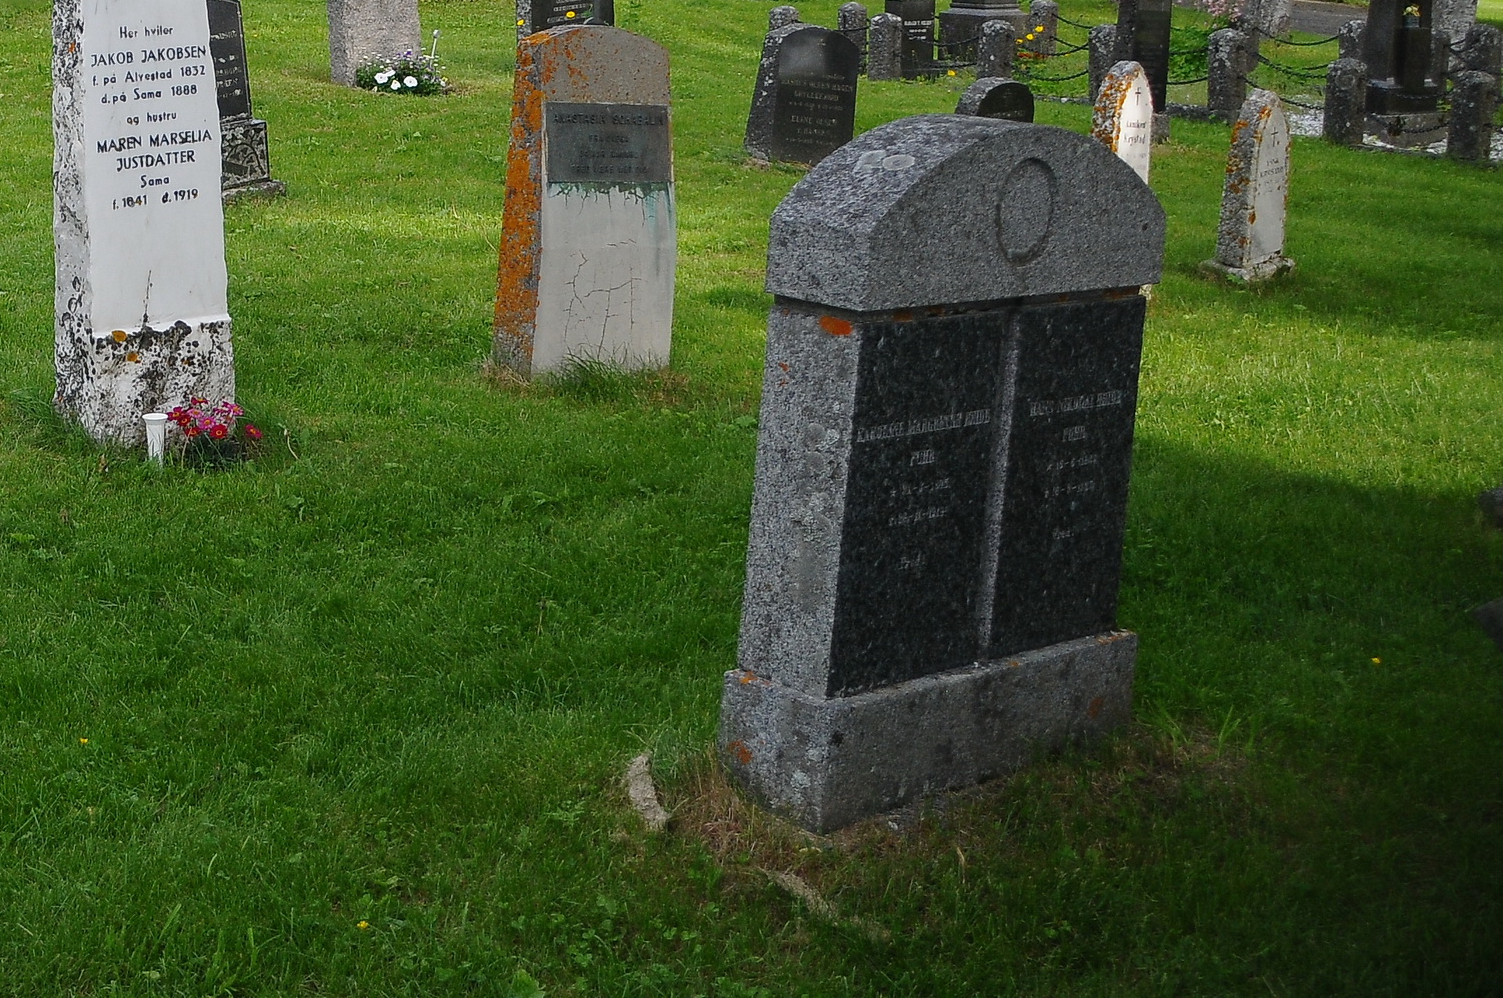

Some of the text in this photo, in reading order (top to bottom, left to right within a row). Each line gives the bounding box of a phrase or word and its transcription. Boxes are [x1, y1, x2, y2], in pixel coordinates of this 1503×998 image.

[119, 25, 174, 39] Her hviler
[90, 45, 207, 68] JAKOB JAKOBSEN
[124, 69, 173, 84] Alvestad
[180, 65, 206, 77] 1832
[171, 84, 198, 96] 1888
[146, 111, 177, 123] hustru
[97, 129, 213, 153] MAREN MARSELIA
[116, 150, 196, 173] JUSTDATTER
